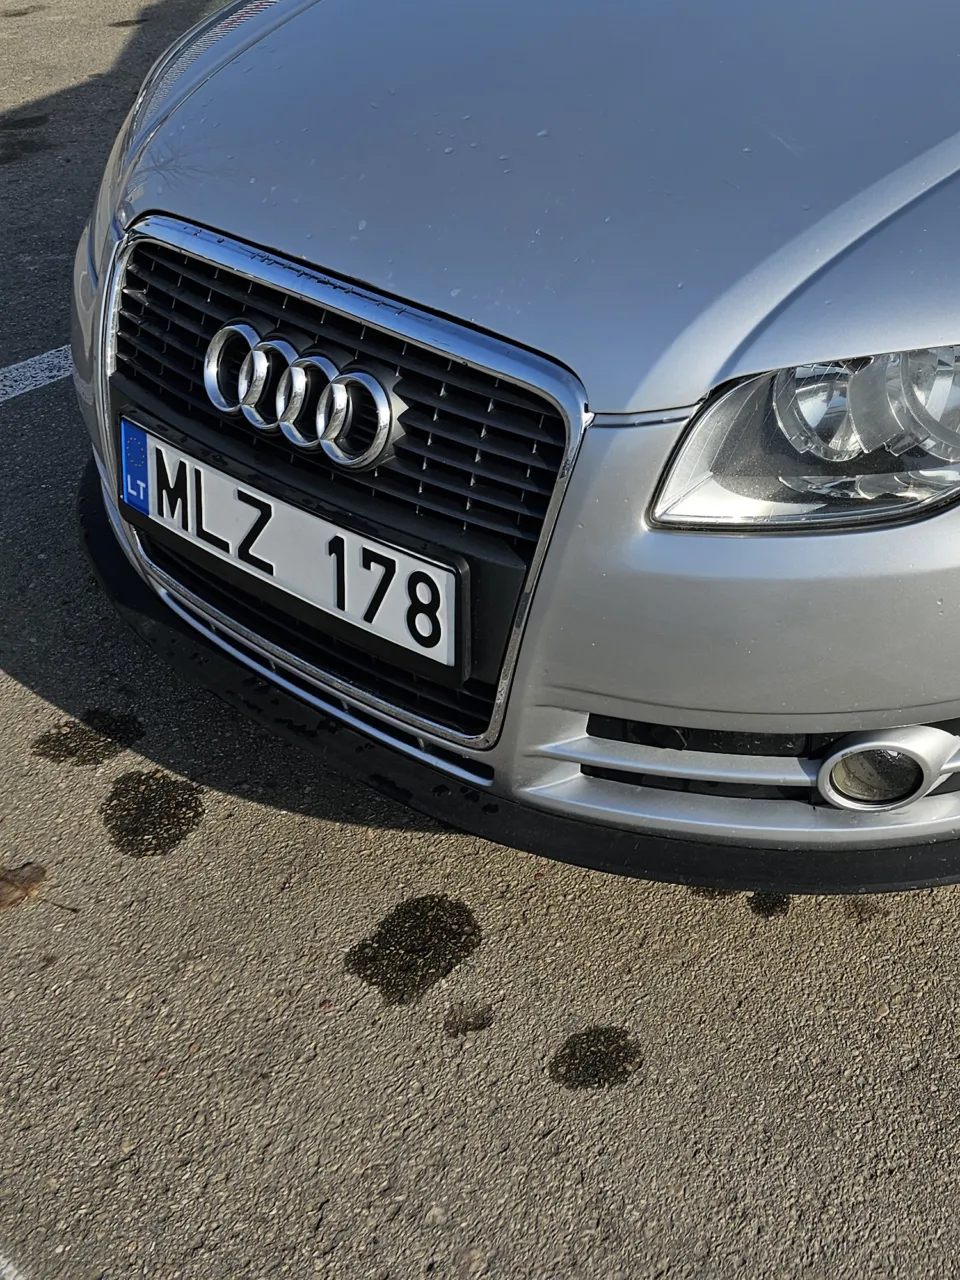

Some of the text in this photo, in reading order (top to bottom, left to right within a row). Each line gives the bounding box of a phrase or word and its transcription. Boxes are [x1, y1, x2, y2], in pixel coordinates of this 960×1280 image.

[126, 446, 442, 649] LT MLZ 178
